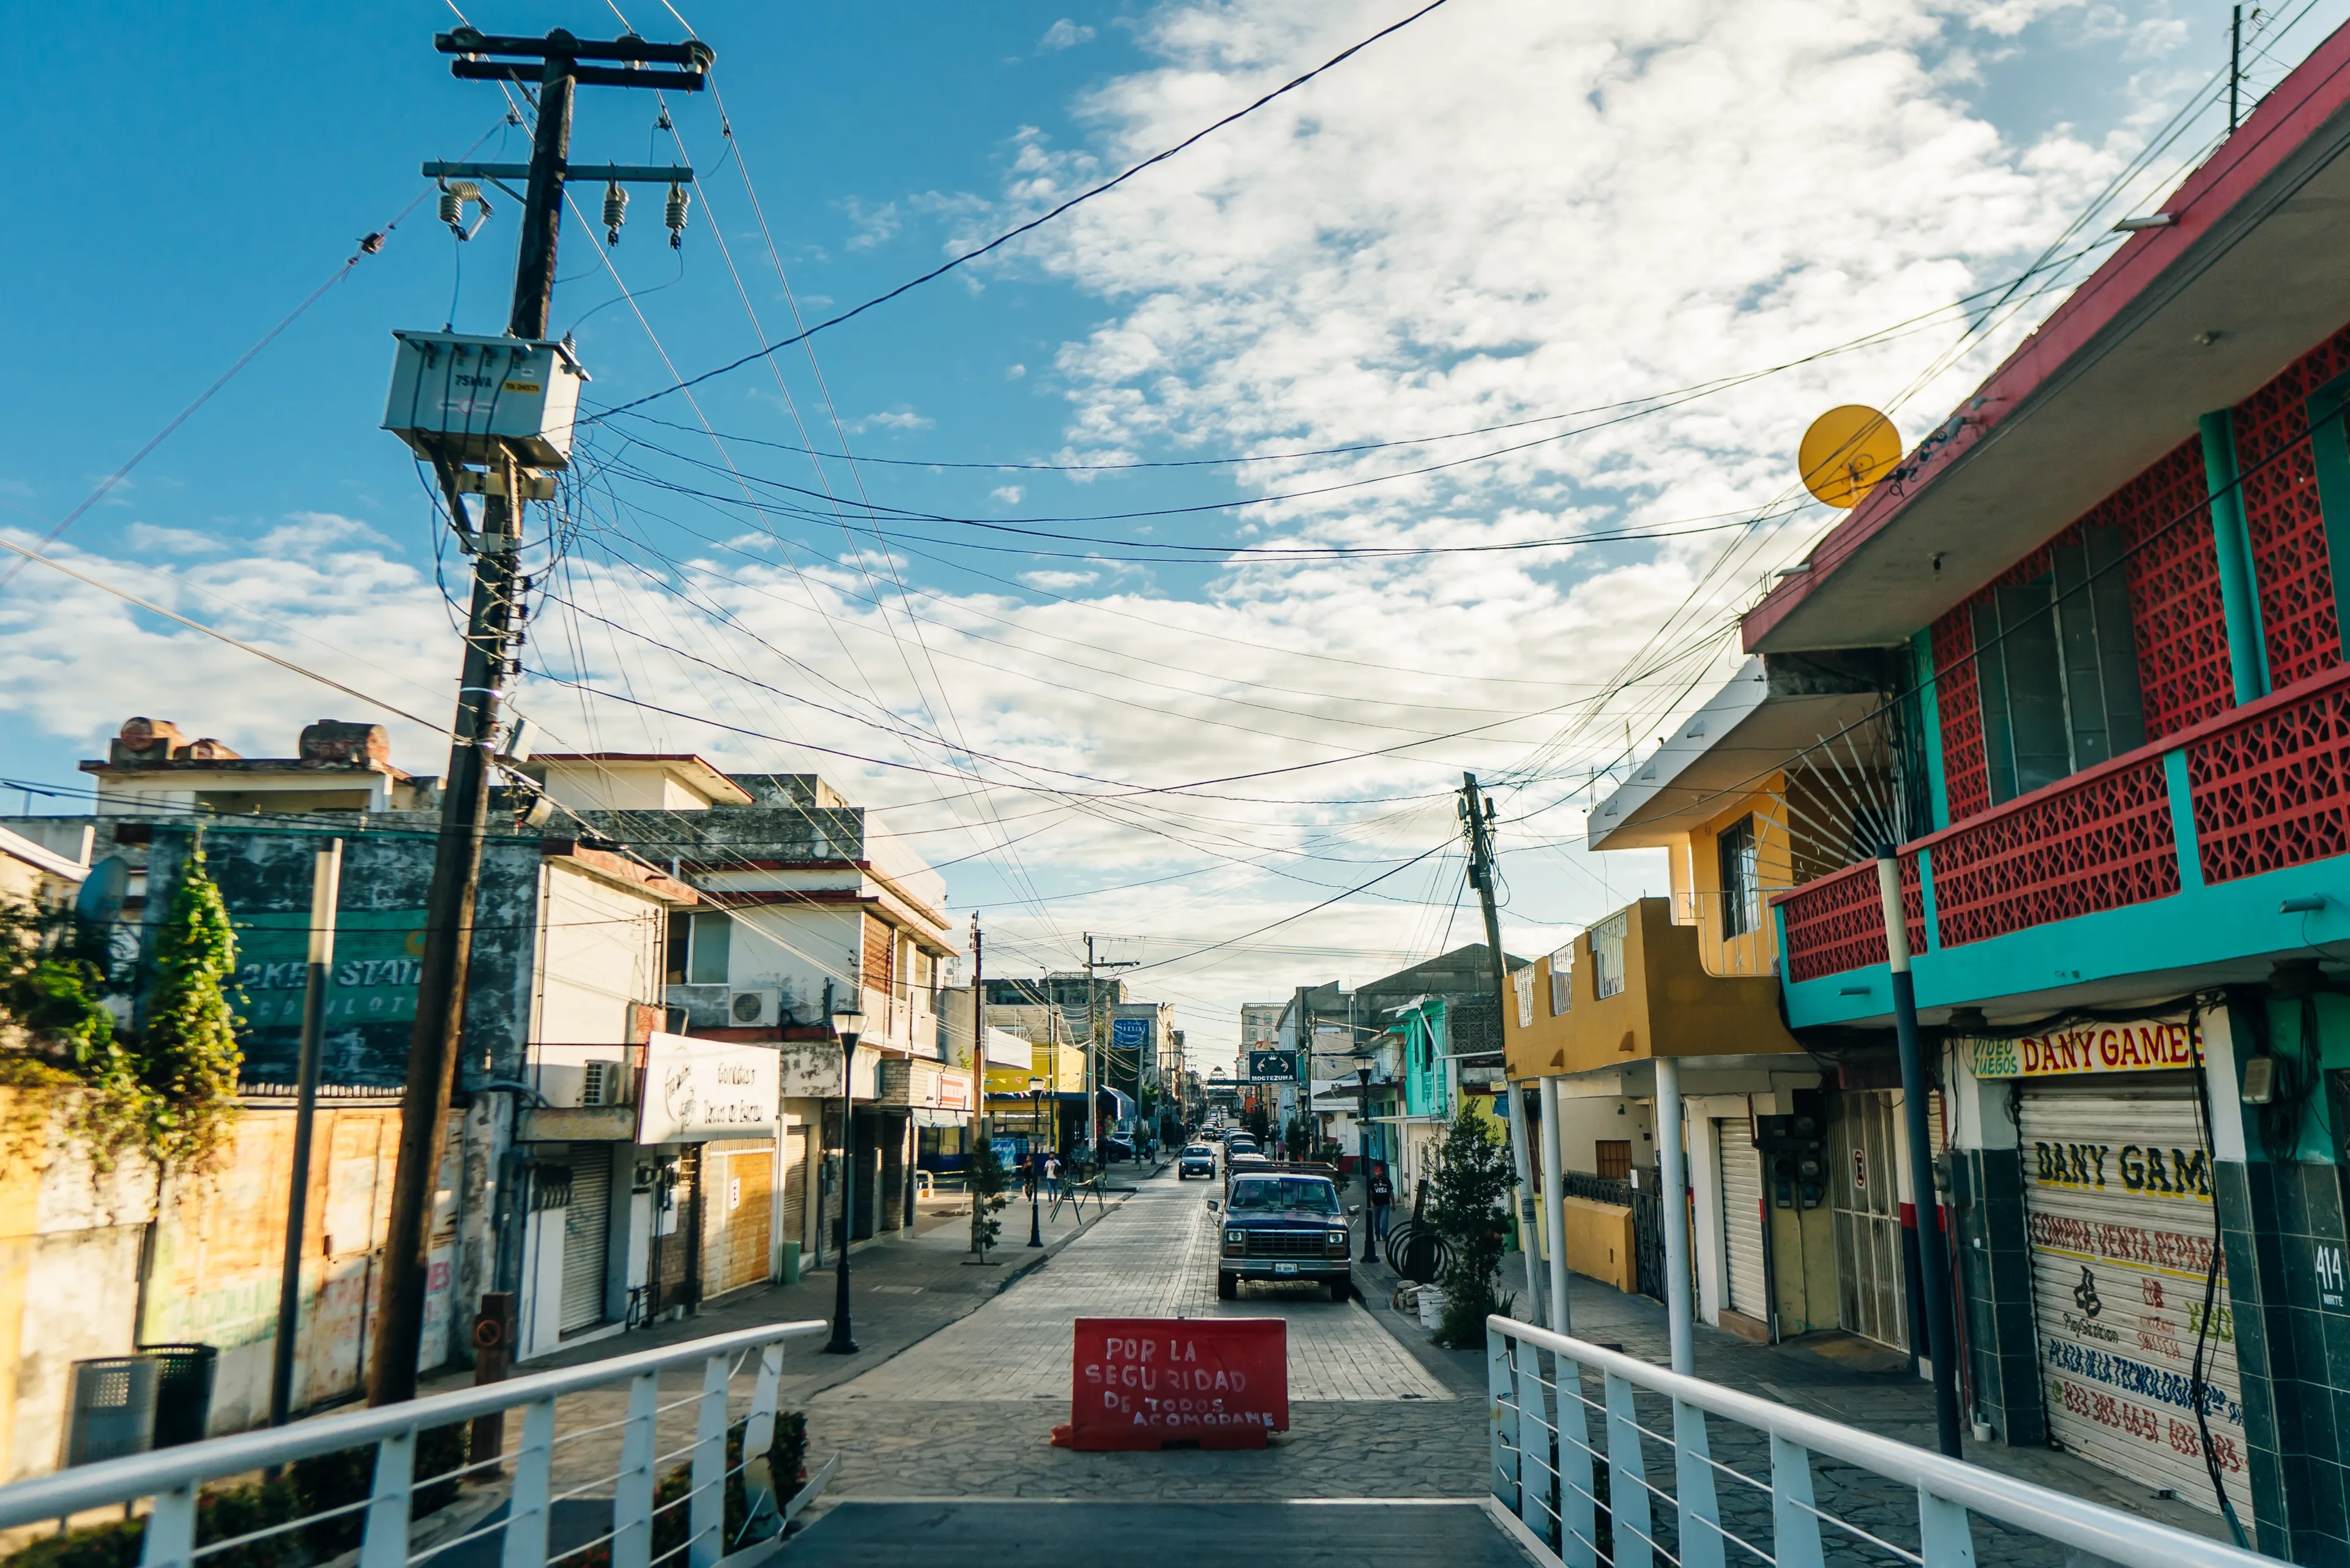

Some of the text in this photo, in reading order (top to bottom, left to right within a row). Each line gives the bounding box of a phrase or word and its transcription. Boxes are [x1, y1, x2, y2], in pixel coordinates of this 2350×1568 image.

[338, 958, 422, 987] STAT
[1974, 1039, 2012, 1056] VIDEO
[2021, 1031, 2095, 1072] DANY
[1972, 1056, 2018, 1075] JUEGOS
[2035, 1142, 2109, 1186] DANY
[2316, 1245, 2344, 1292] 414
[1106, 1338, 1196, 1362] POR LA
[1085, 1364, 1246, 1392] SEGURIDAD
[1104, 1391, 1224, 1413] DE TODOS
